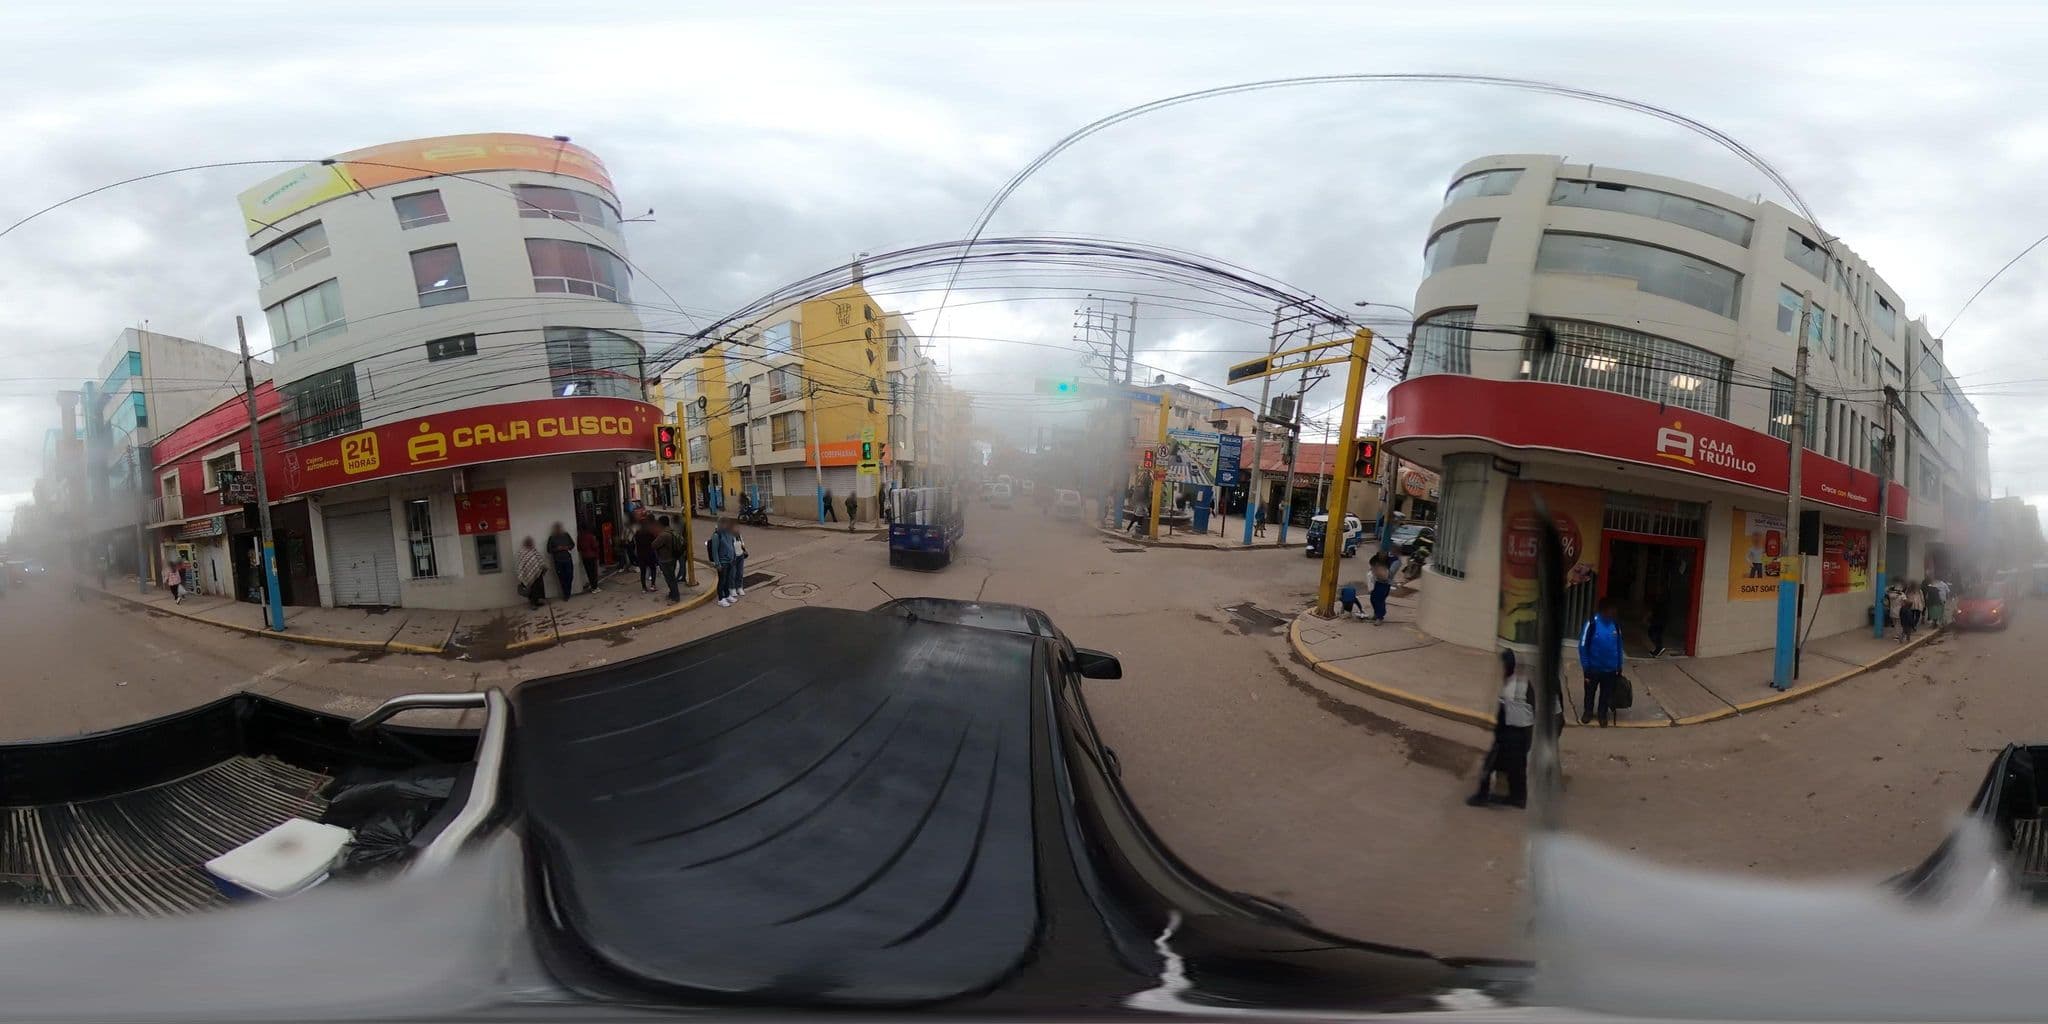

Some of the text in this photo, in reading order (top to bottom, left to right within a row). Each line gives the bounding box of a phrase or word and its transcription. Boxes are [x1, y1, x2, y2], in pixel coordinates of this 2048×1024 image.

[452, 416, 633, 448] CAJA CUSCO
[346, 437, 375, 461] 24
[1699, 437, 1734, 456] CAJA
[348, 457, 377, 470] HORAS
[1699, 449, 1757, 473] TRUJILLO
[1741, 584, 1759, 594] SOAT
[1760, 585, 1777, 593] SOAT
